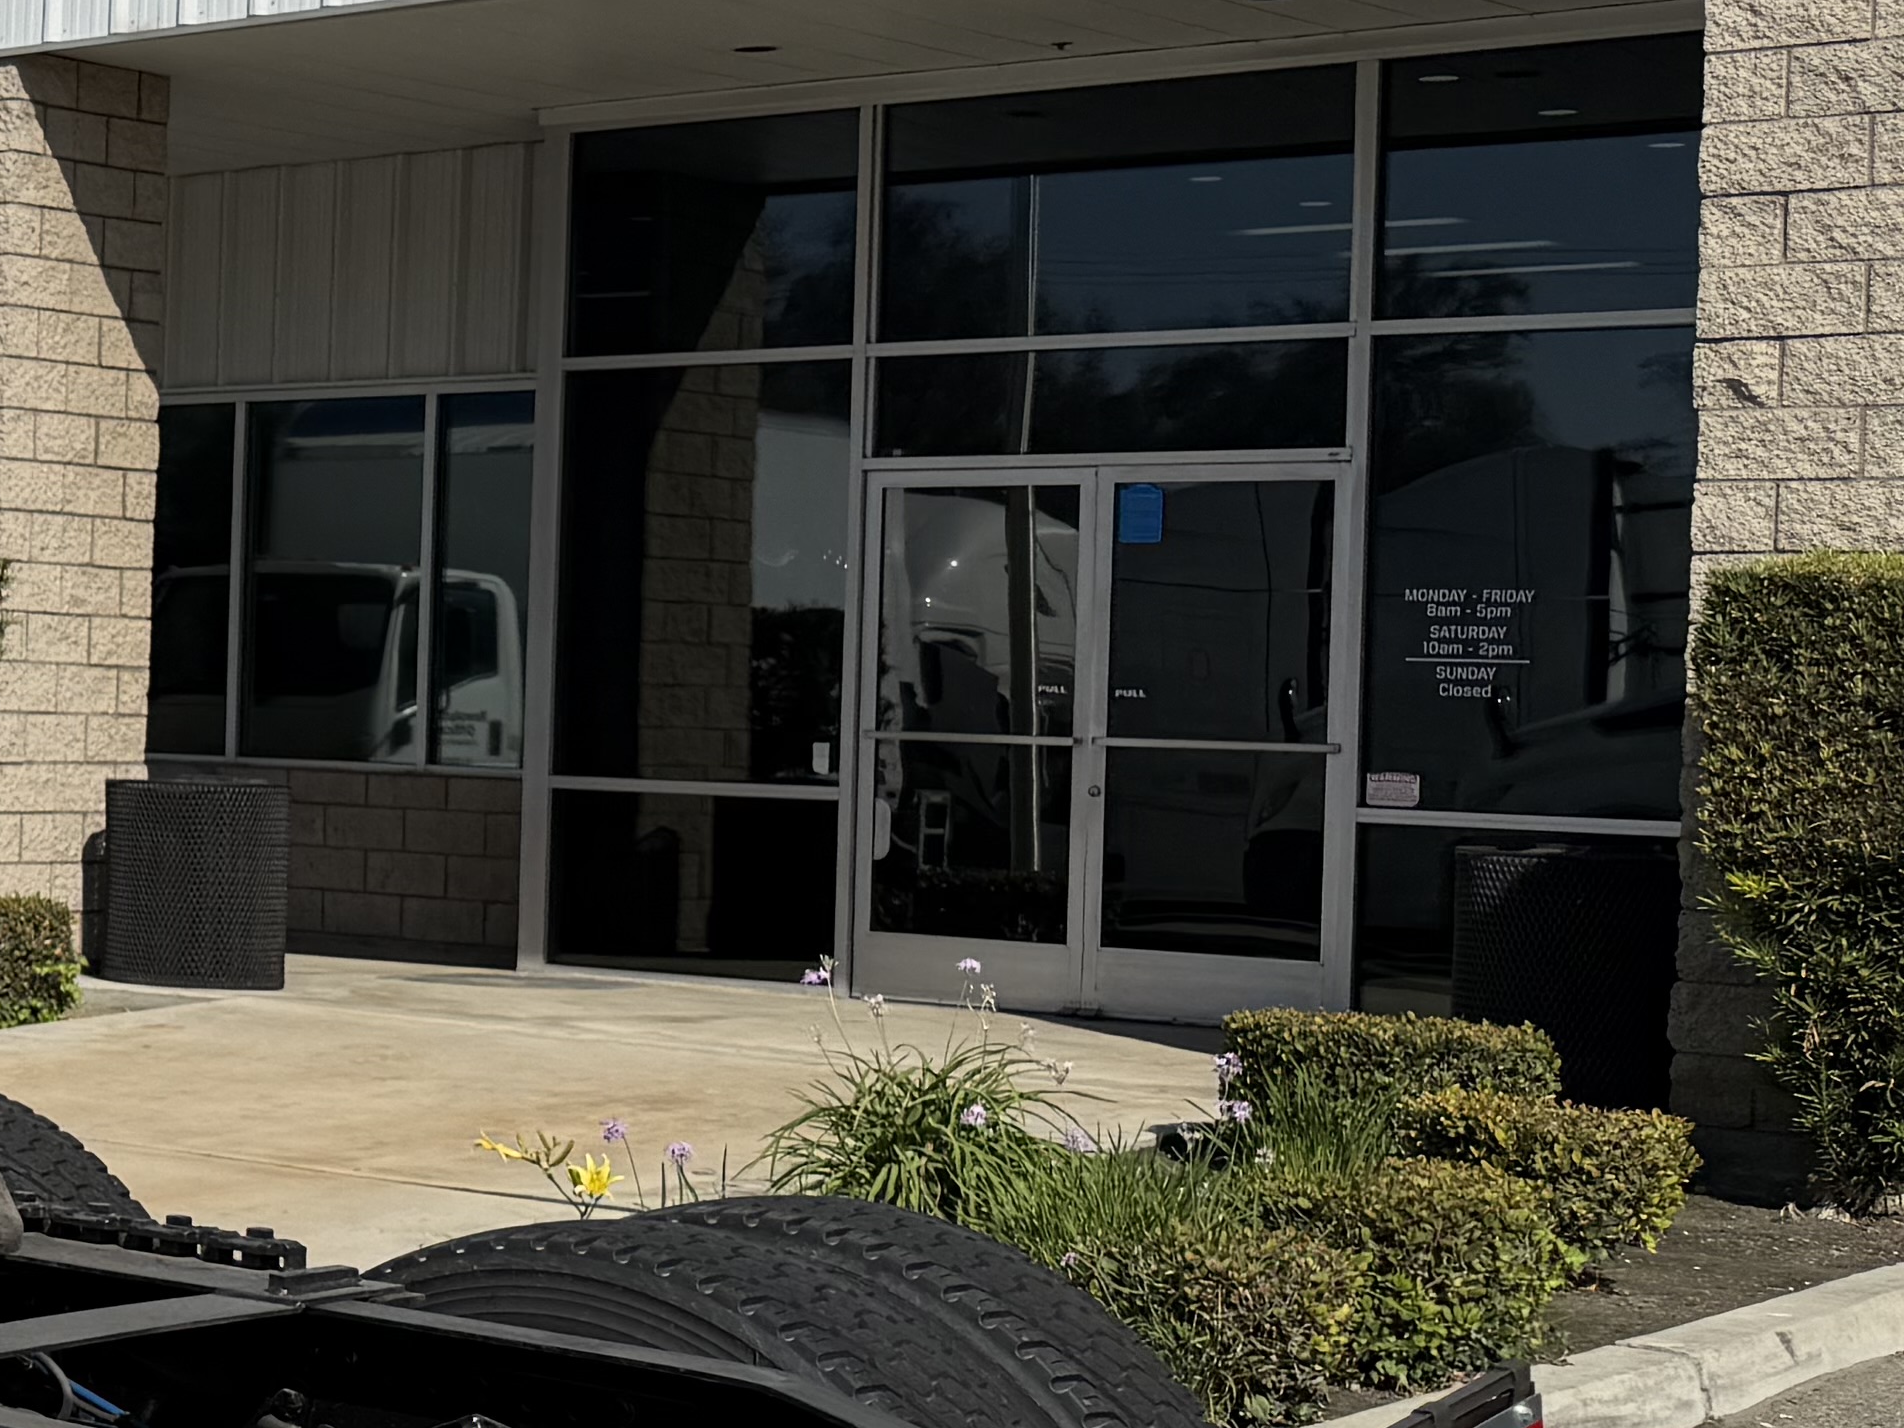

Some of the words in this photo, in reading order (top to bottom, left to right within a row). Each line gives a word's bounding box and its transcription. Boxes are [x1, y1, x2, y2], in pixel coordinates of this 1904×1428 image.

[1404, 588, 1467, 603] MONDAY
[1482, 589, 1535, 604] FRIDAY
[1426, 604, 1461, 617] 8am
[1476, 605, 1512, 620] 5pm
[1429, 625, 1507, 640] SATURDAY
[1423, 641, 1463, 655] 10am
[1478, 642, 1513, 658] 2pm
[1435, 666, 1497, 681] SUNDAY
[1115, 689, 1146, 698] PULL
[1439, 683, 1492, 698] Closed
